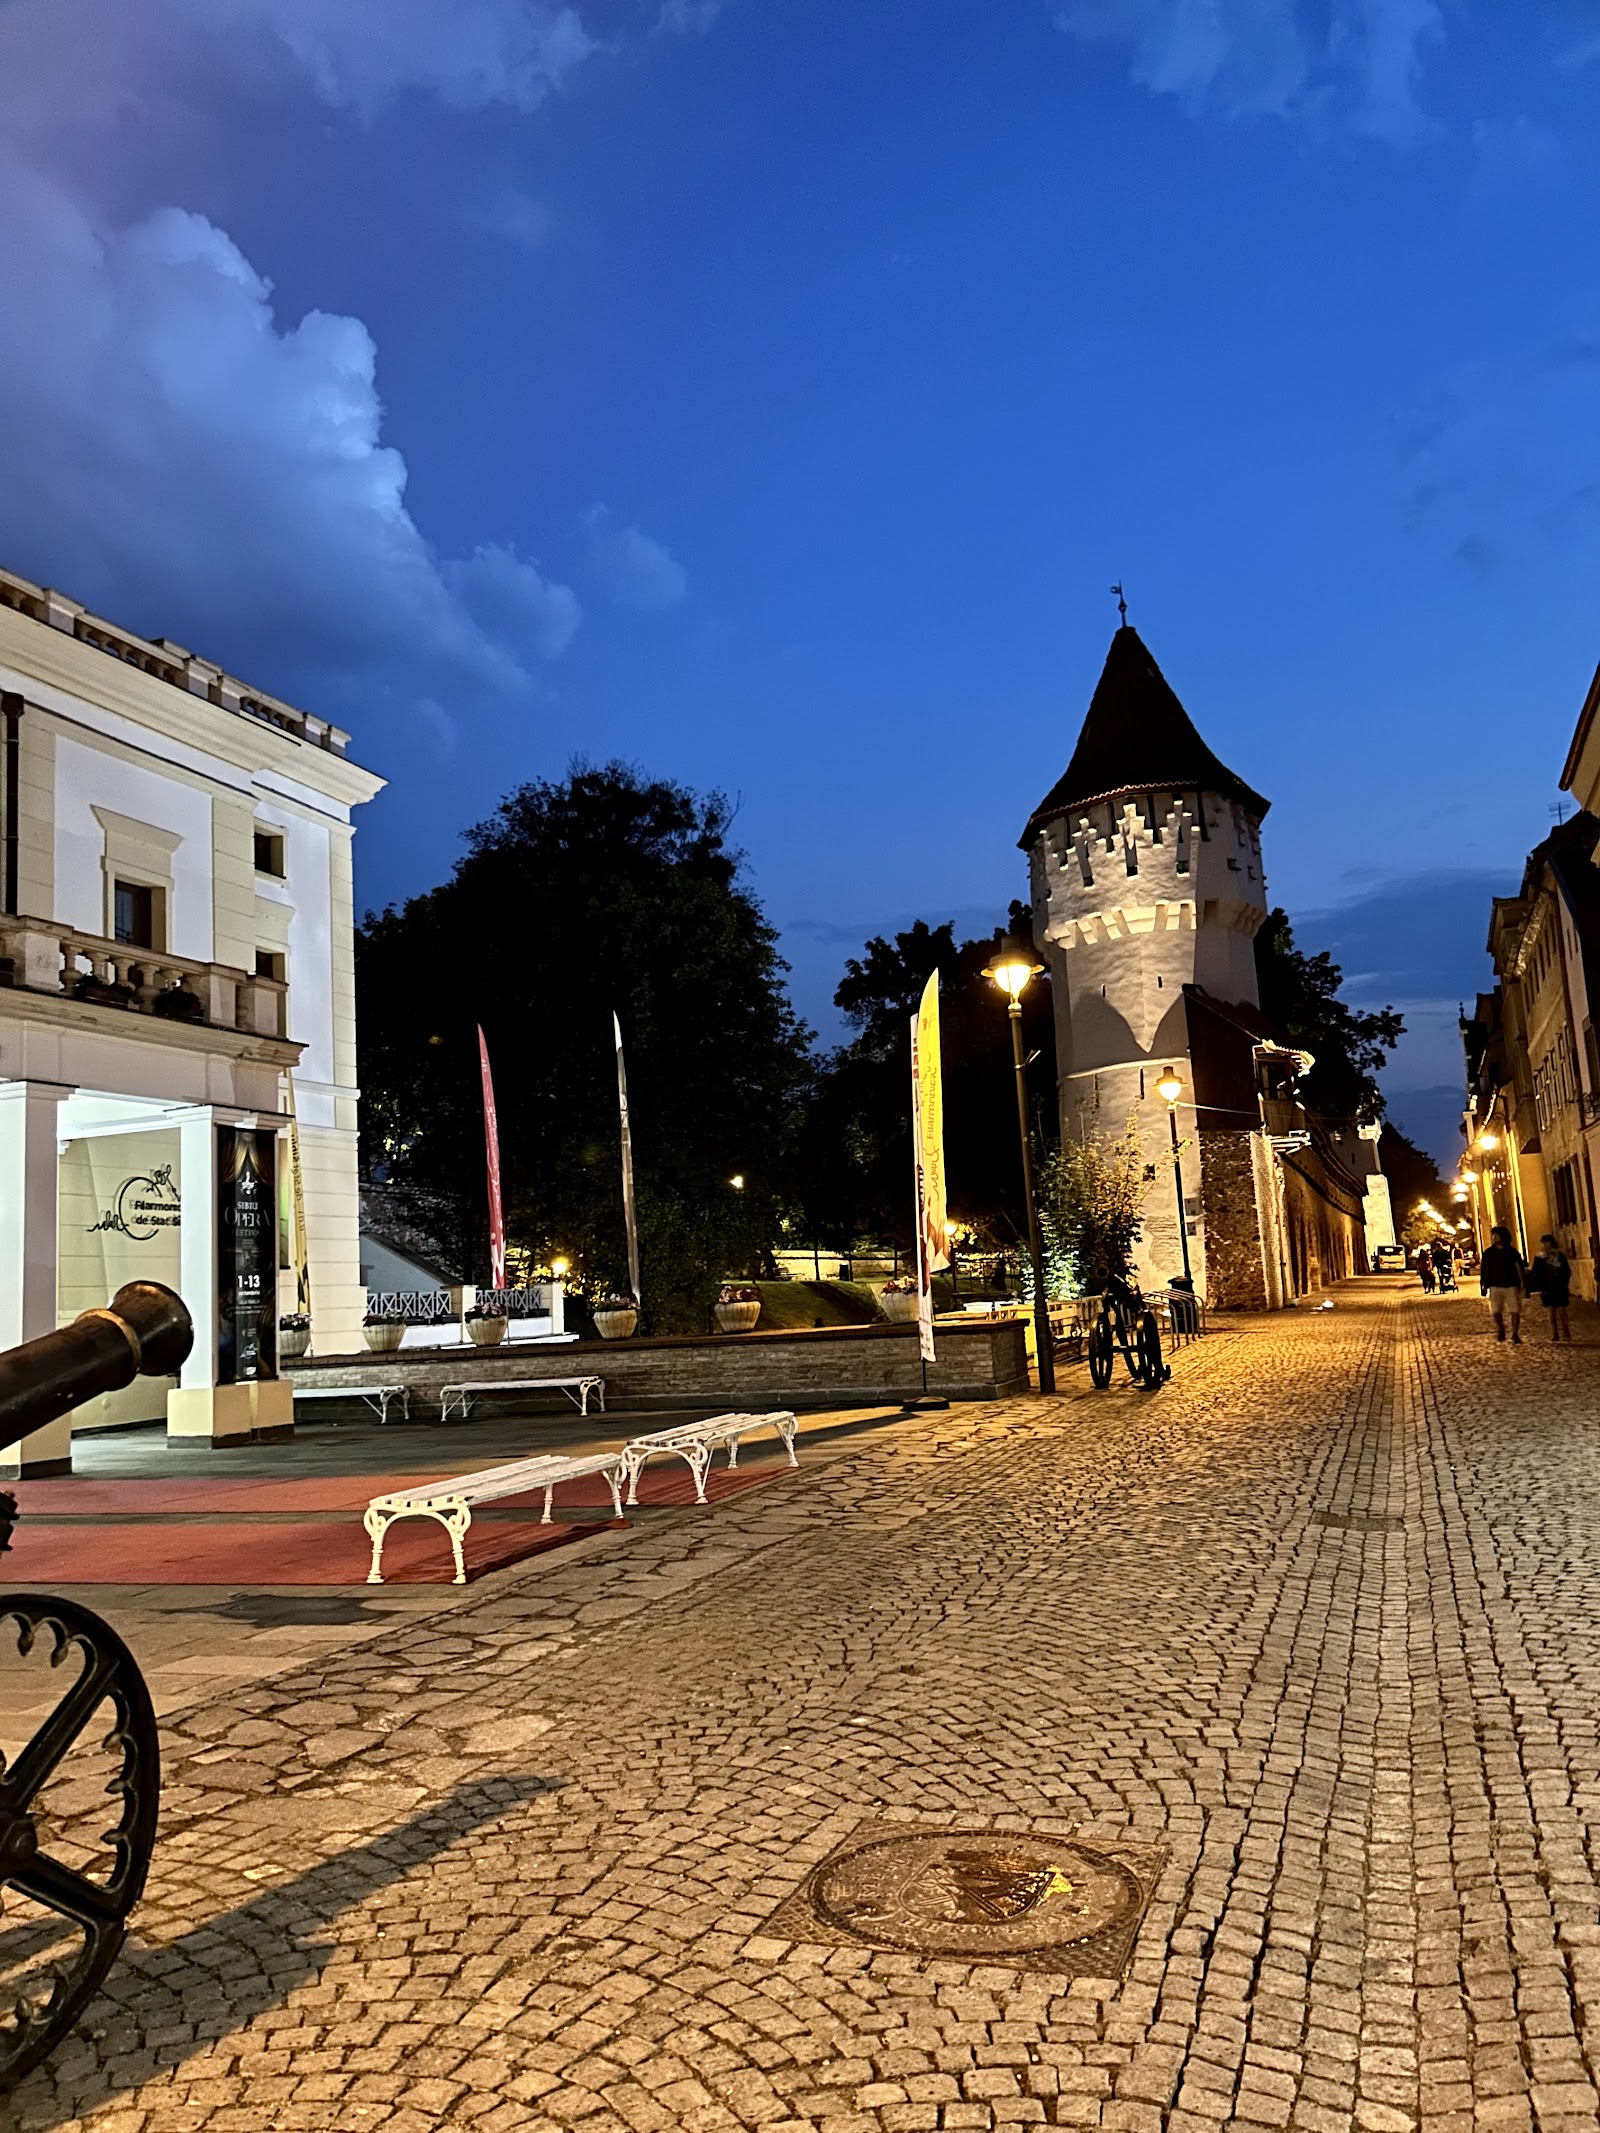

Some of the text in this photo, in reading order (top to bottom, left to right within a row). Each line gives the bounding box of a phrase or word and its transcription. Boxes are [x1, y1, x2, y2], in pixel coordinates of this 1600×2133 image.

[237, 1201, 259, 1210] SIBIU
[135, 1214, 148, 1225] de
[237, 1275, 260, 1288] 1-13
